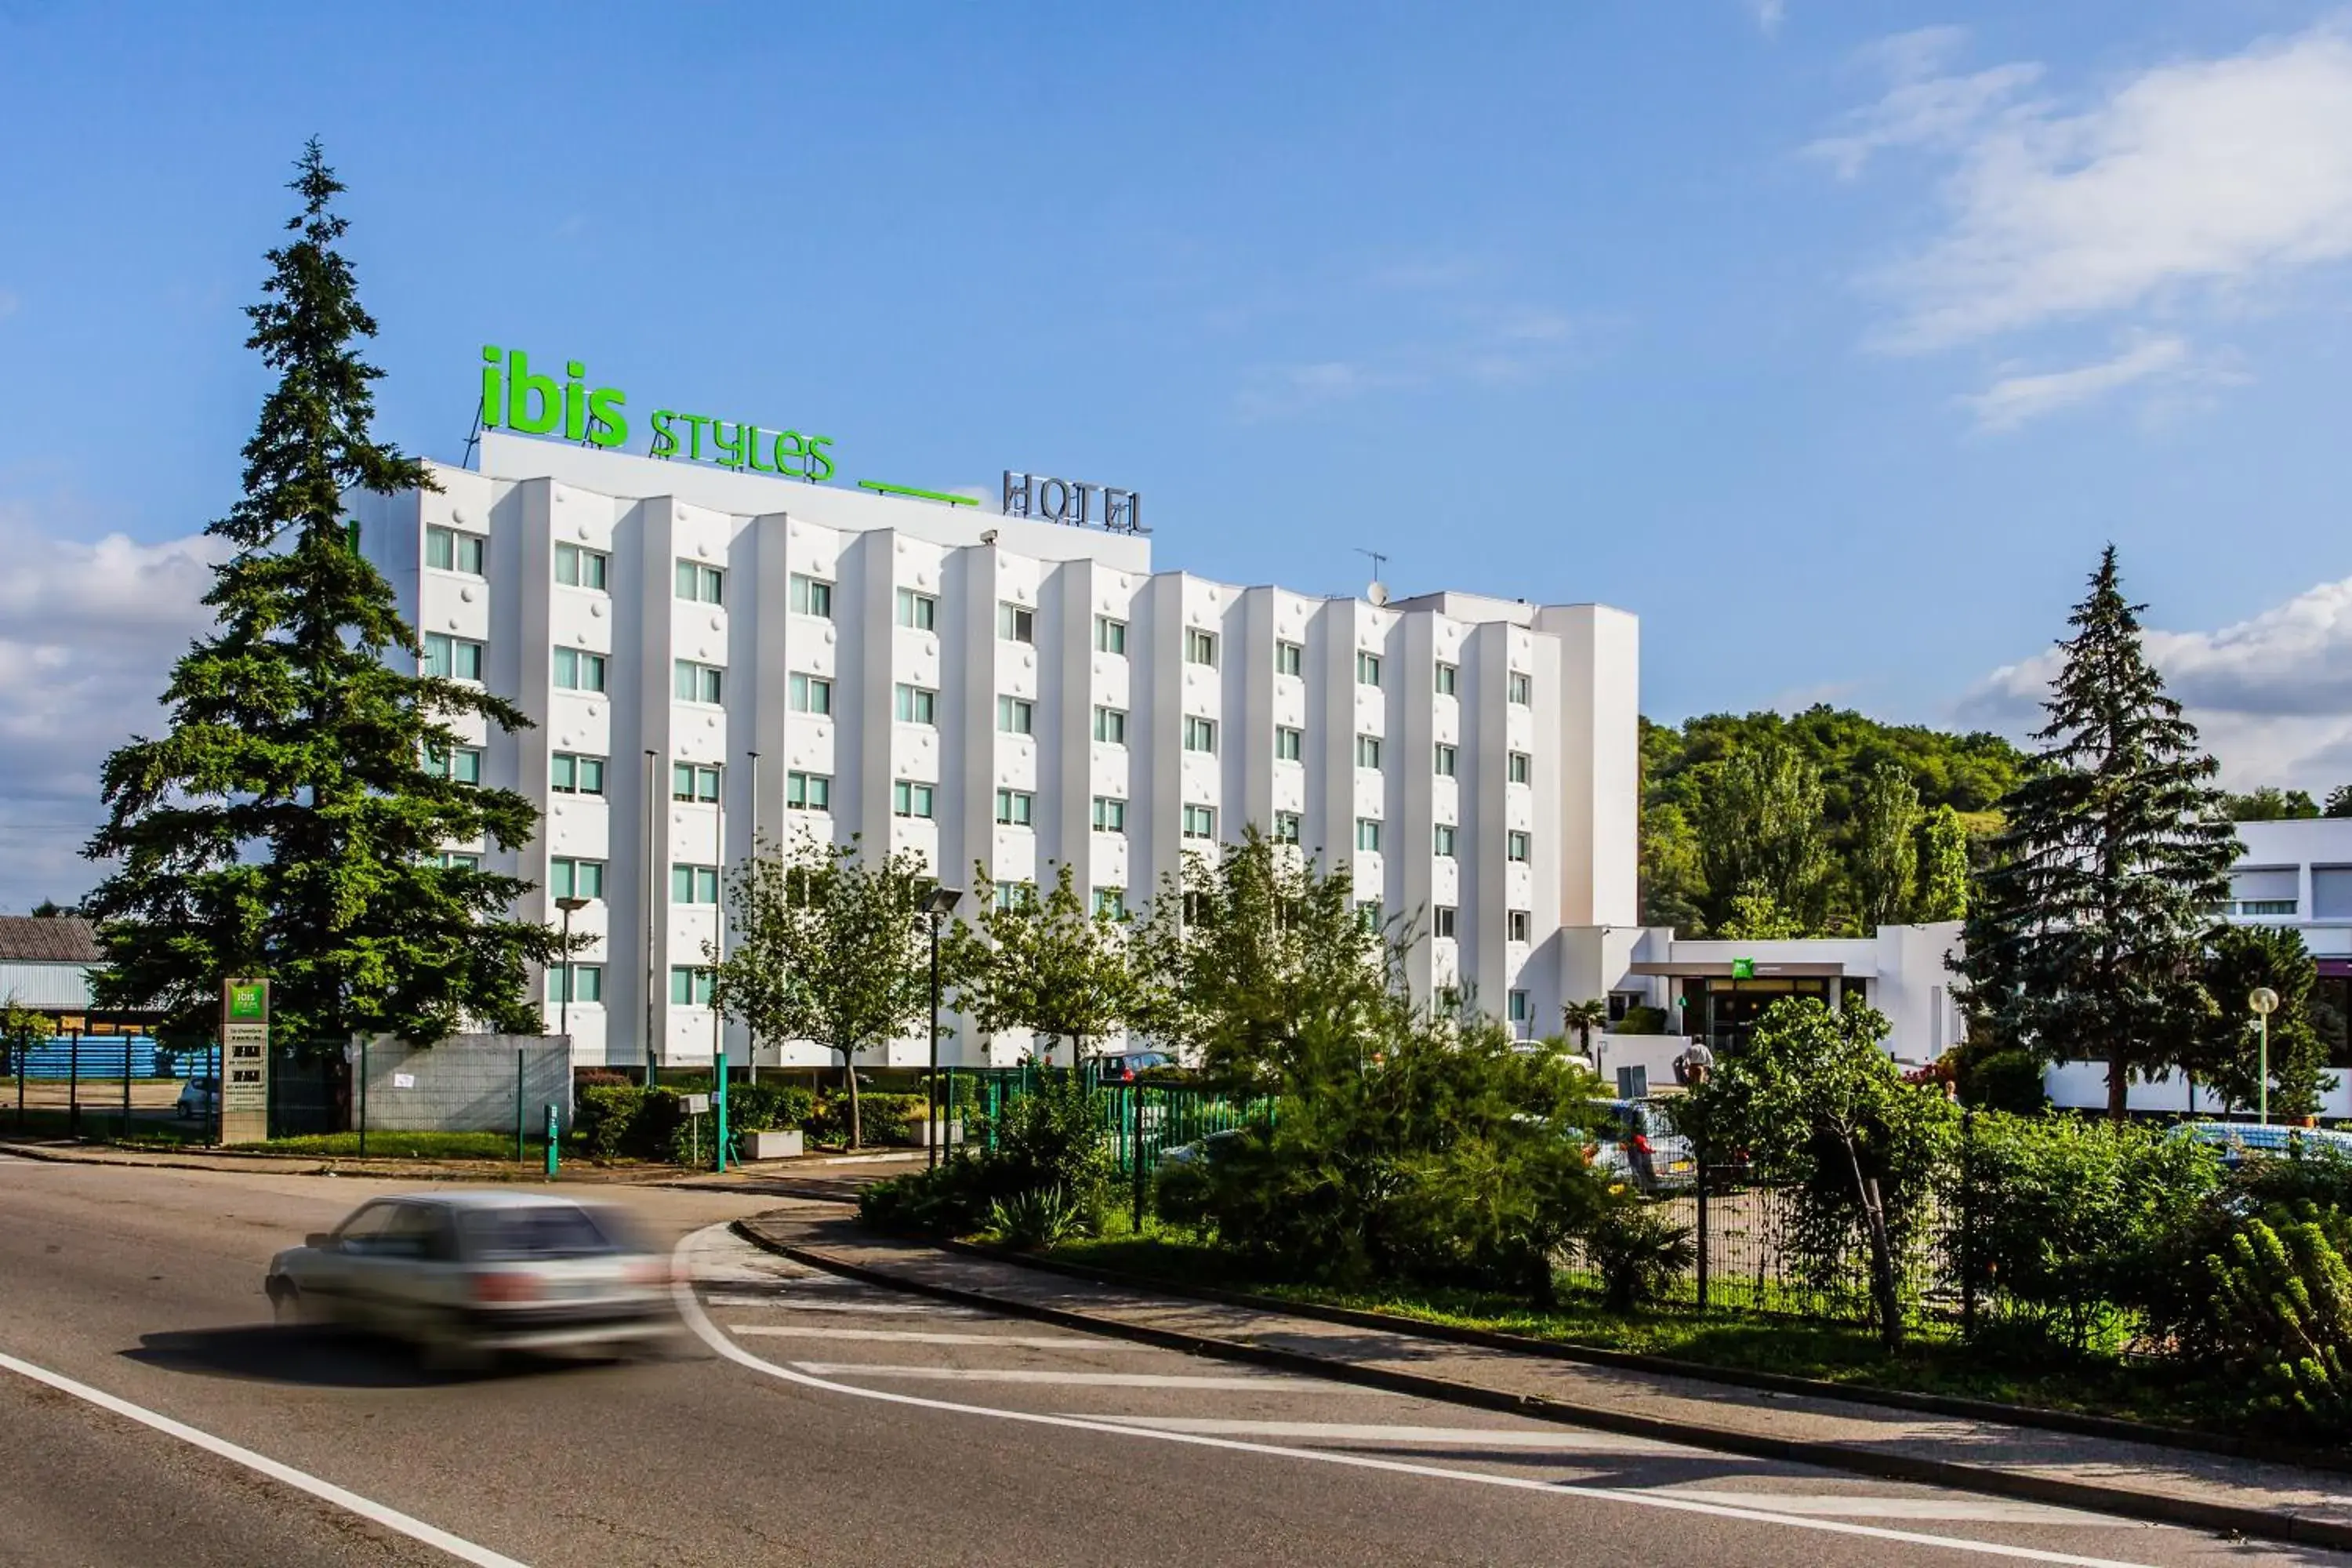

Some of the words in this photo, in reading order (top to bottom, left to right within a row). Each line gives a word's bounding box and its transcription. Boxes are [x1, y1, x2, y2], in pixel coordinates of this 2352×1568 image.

[483, 345, 629, 447] ibis
[1004, 470, 1153, 533] HOTEL
[238, 990, 256, 1001] ibis
